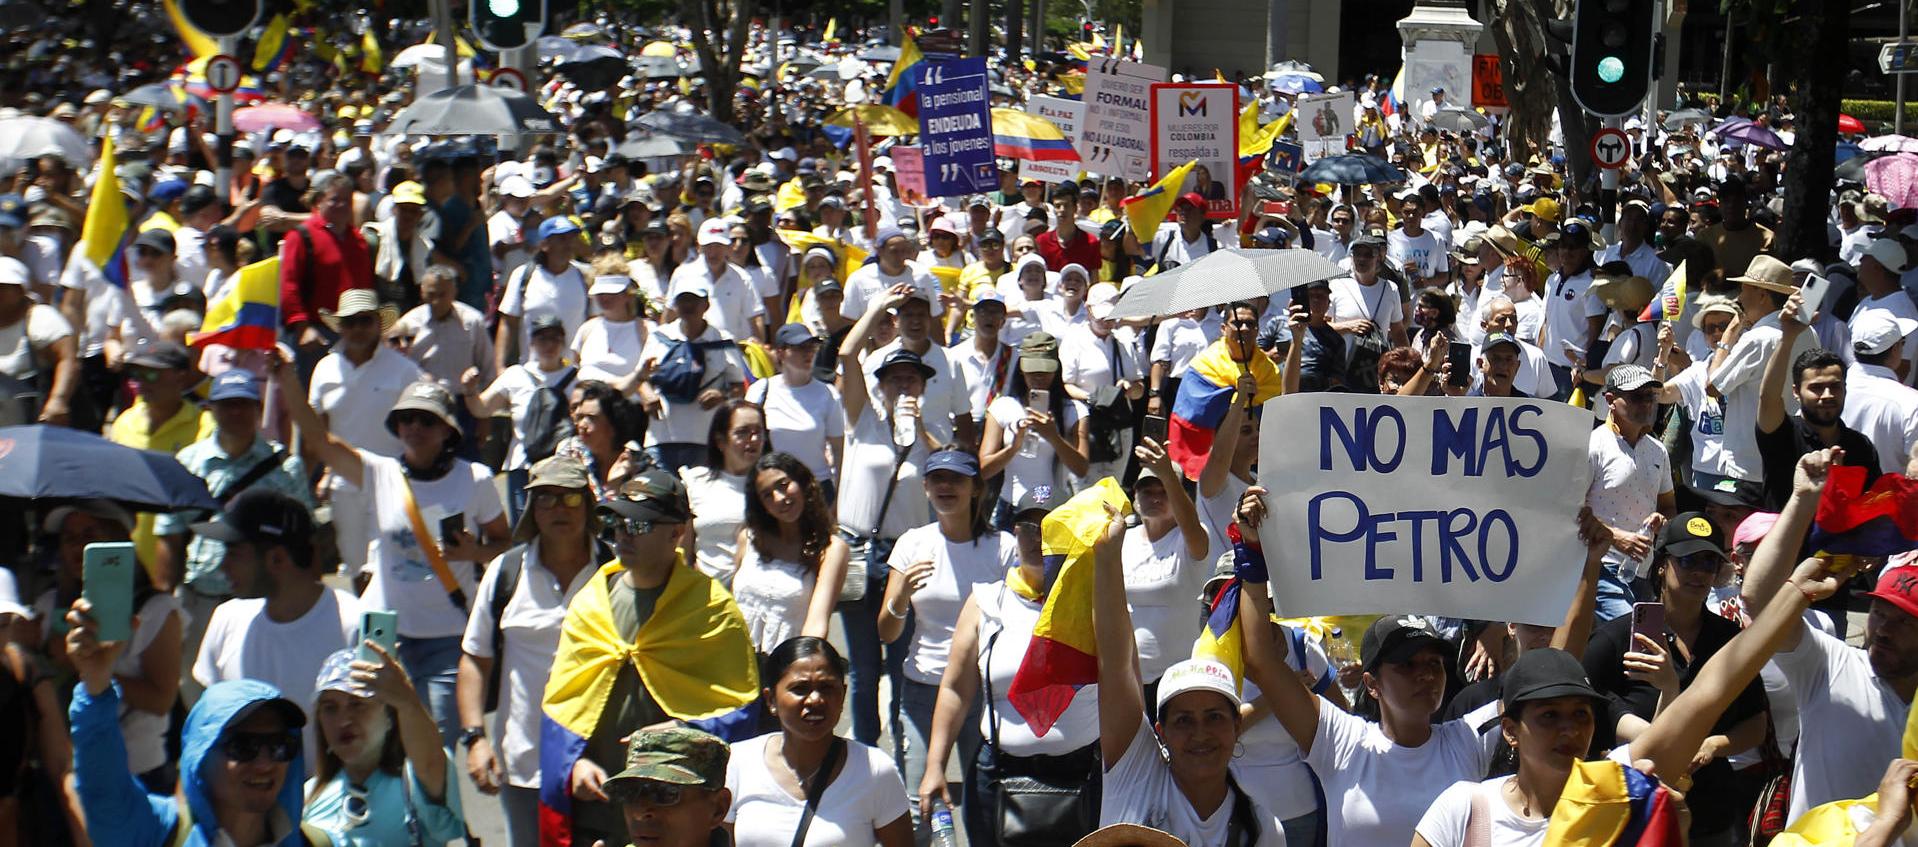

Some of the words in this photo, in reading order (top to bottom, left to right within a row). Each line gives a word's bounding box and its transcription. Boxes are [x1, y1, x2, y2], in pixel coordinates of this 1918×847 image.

[921, 93, 932, 109] la
[933, 85, 984, 111] pensional
[1096, 91, 1148, 111] FORMAL
[927, 112, 982, 135] ENDEUDA
[1167, 123, 1202, 132] MUJERES
[1203, 123, 1219, 132] POR
[1170, 133, 1216, 141] COLOMBIA
[923, 143, 932, 156] a
[932, 140, 948, 155] los
[1168, 145, 1211, 160] respalda
[1212, 148, 1220, 157] a
[1028, 163, 1069, 176] ABSOLUTA
[1319, 404, 1406, 474] NO
[1430, 404, 1548, 478] MAS
[1308, 490, 1519, 583] PETRO
